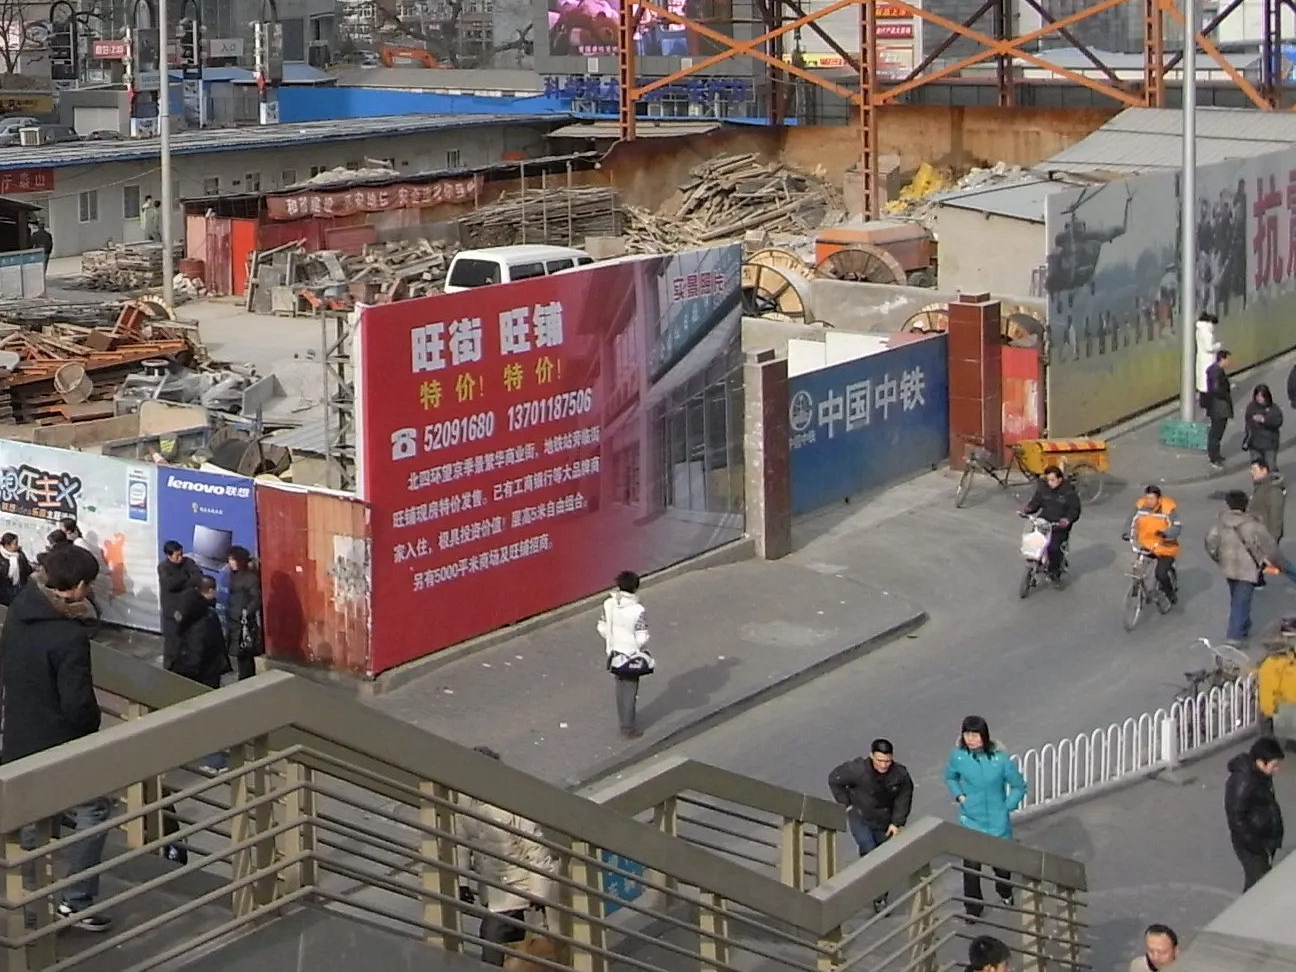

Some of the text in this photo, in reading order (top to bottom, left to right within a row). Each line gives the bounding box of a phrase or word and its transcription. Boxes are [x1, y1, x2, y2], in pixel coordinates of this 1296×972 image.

[673, 271, 724, 301] 实景照片
[411, 300, 564, 373] 旺街 旺铺
[424, 388, 592, 452] 52091680 13701187506
[818, 366, 925, 439] 中国中铁
[167, 475, 250, 498] lenovo联想
